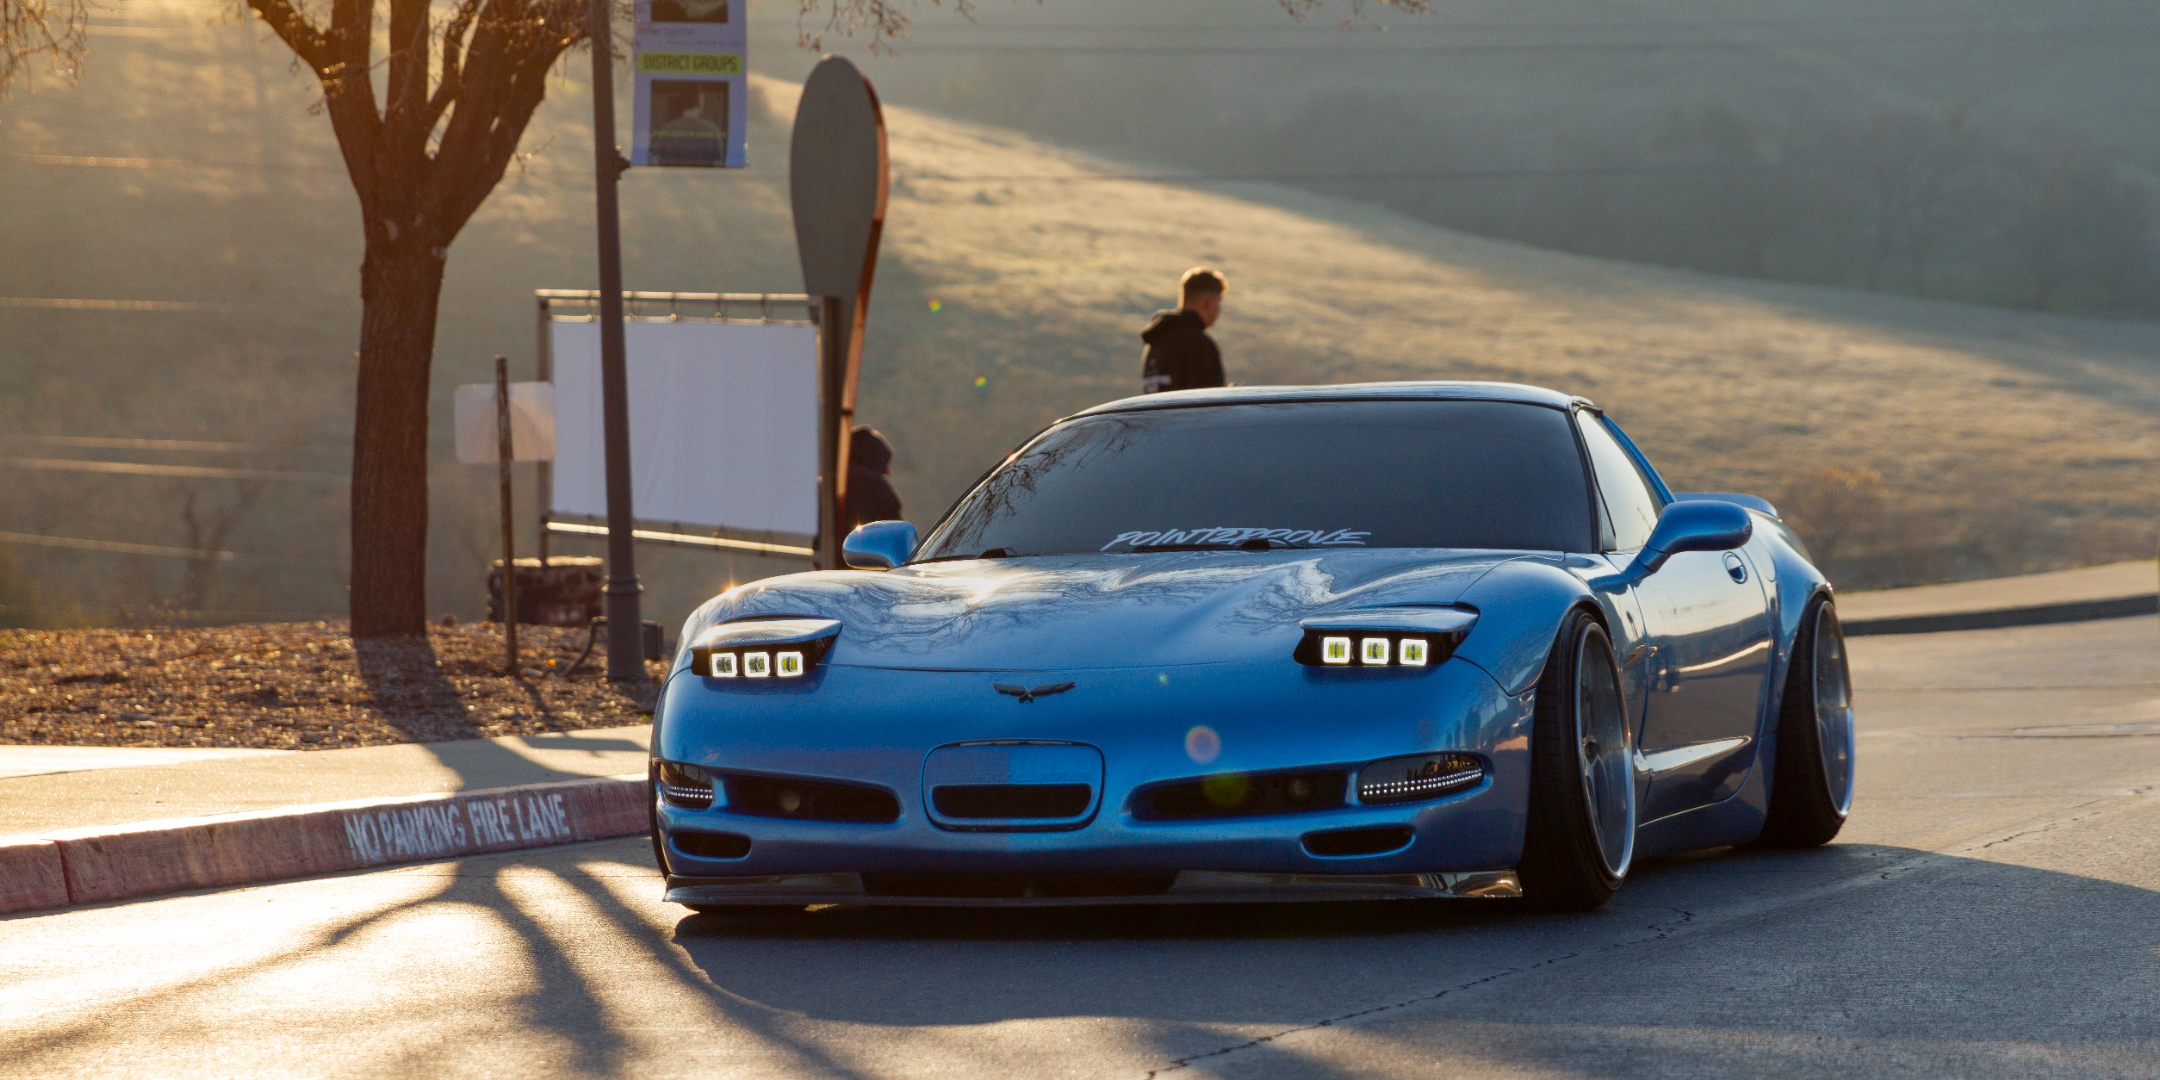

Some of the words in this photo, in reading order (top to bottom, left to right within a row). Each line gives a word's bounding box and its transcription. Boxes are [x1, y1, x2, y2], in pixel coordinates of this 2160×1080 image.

[644, 53, 690, 71] DISTRICT
[692, 54, 738, 72] GROUPS
[343, 811, 381, 862] NO
[378, 804, 466, 857] PARKING
[467, 799, 515, 846] FIRE
[513, 794, 571, 841] LANE
